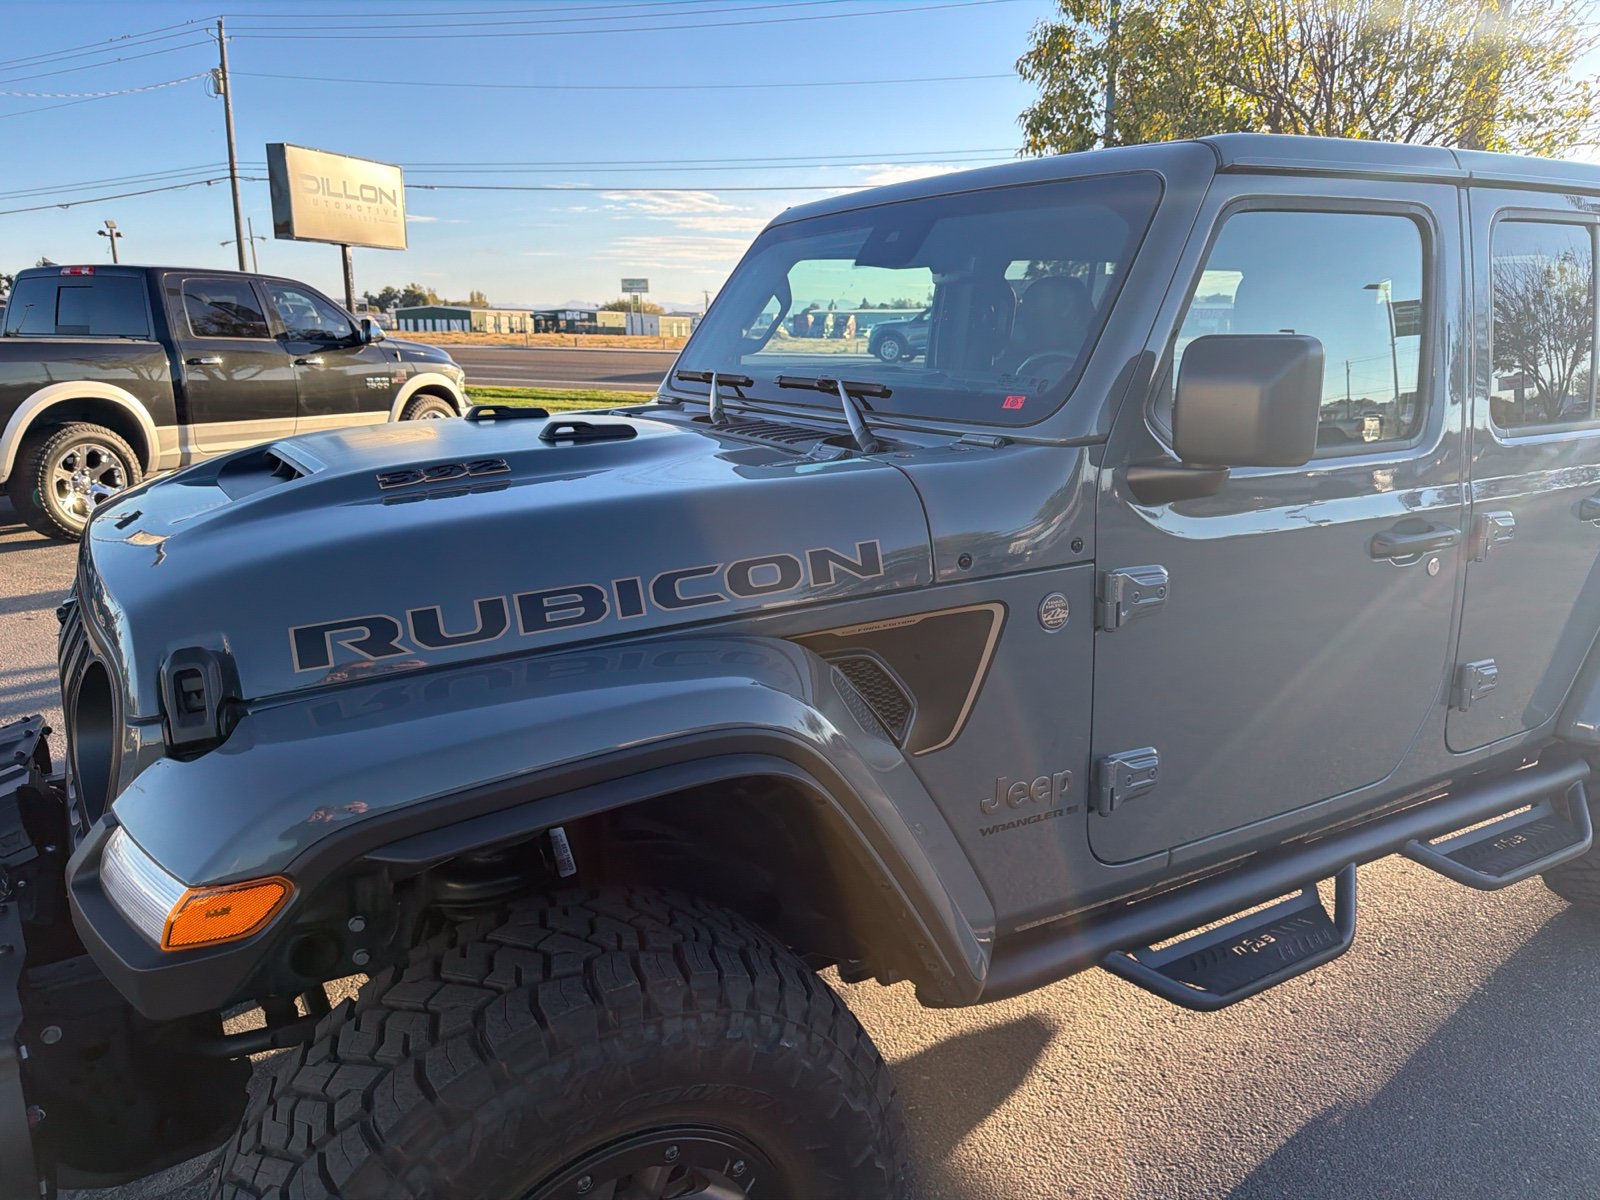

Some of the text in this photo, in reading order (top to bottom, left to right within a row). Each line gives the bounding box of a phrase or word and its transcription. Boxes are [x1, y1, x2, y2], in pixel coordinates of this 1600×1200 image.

[299, 174, 397, 207] DILLON
[288, 539, 886, 673] RUBICON
[980, 769, 1073, 816] Jeep
[979, 808, 1064, 837] WRANGLER
